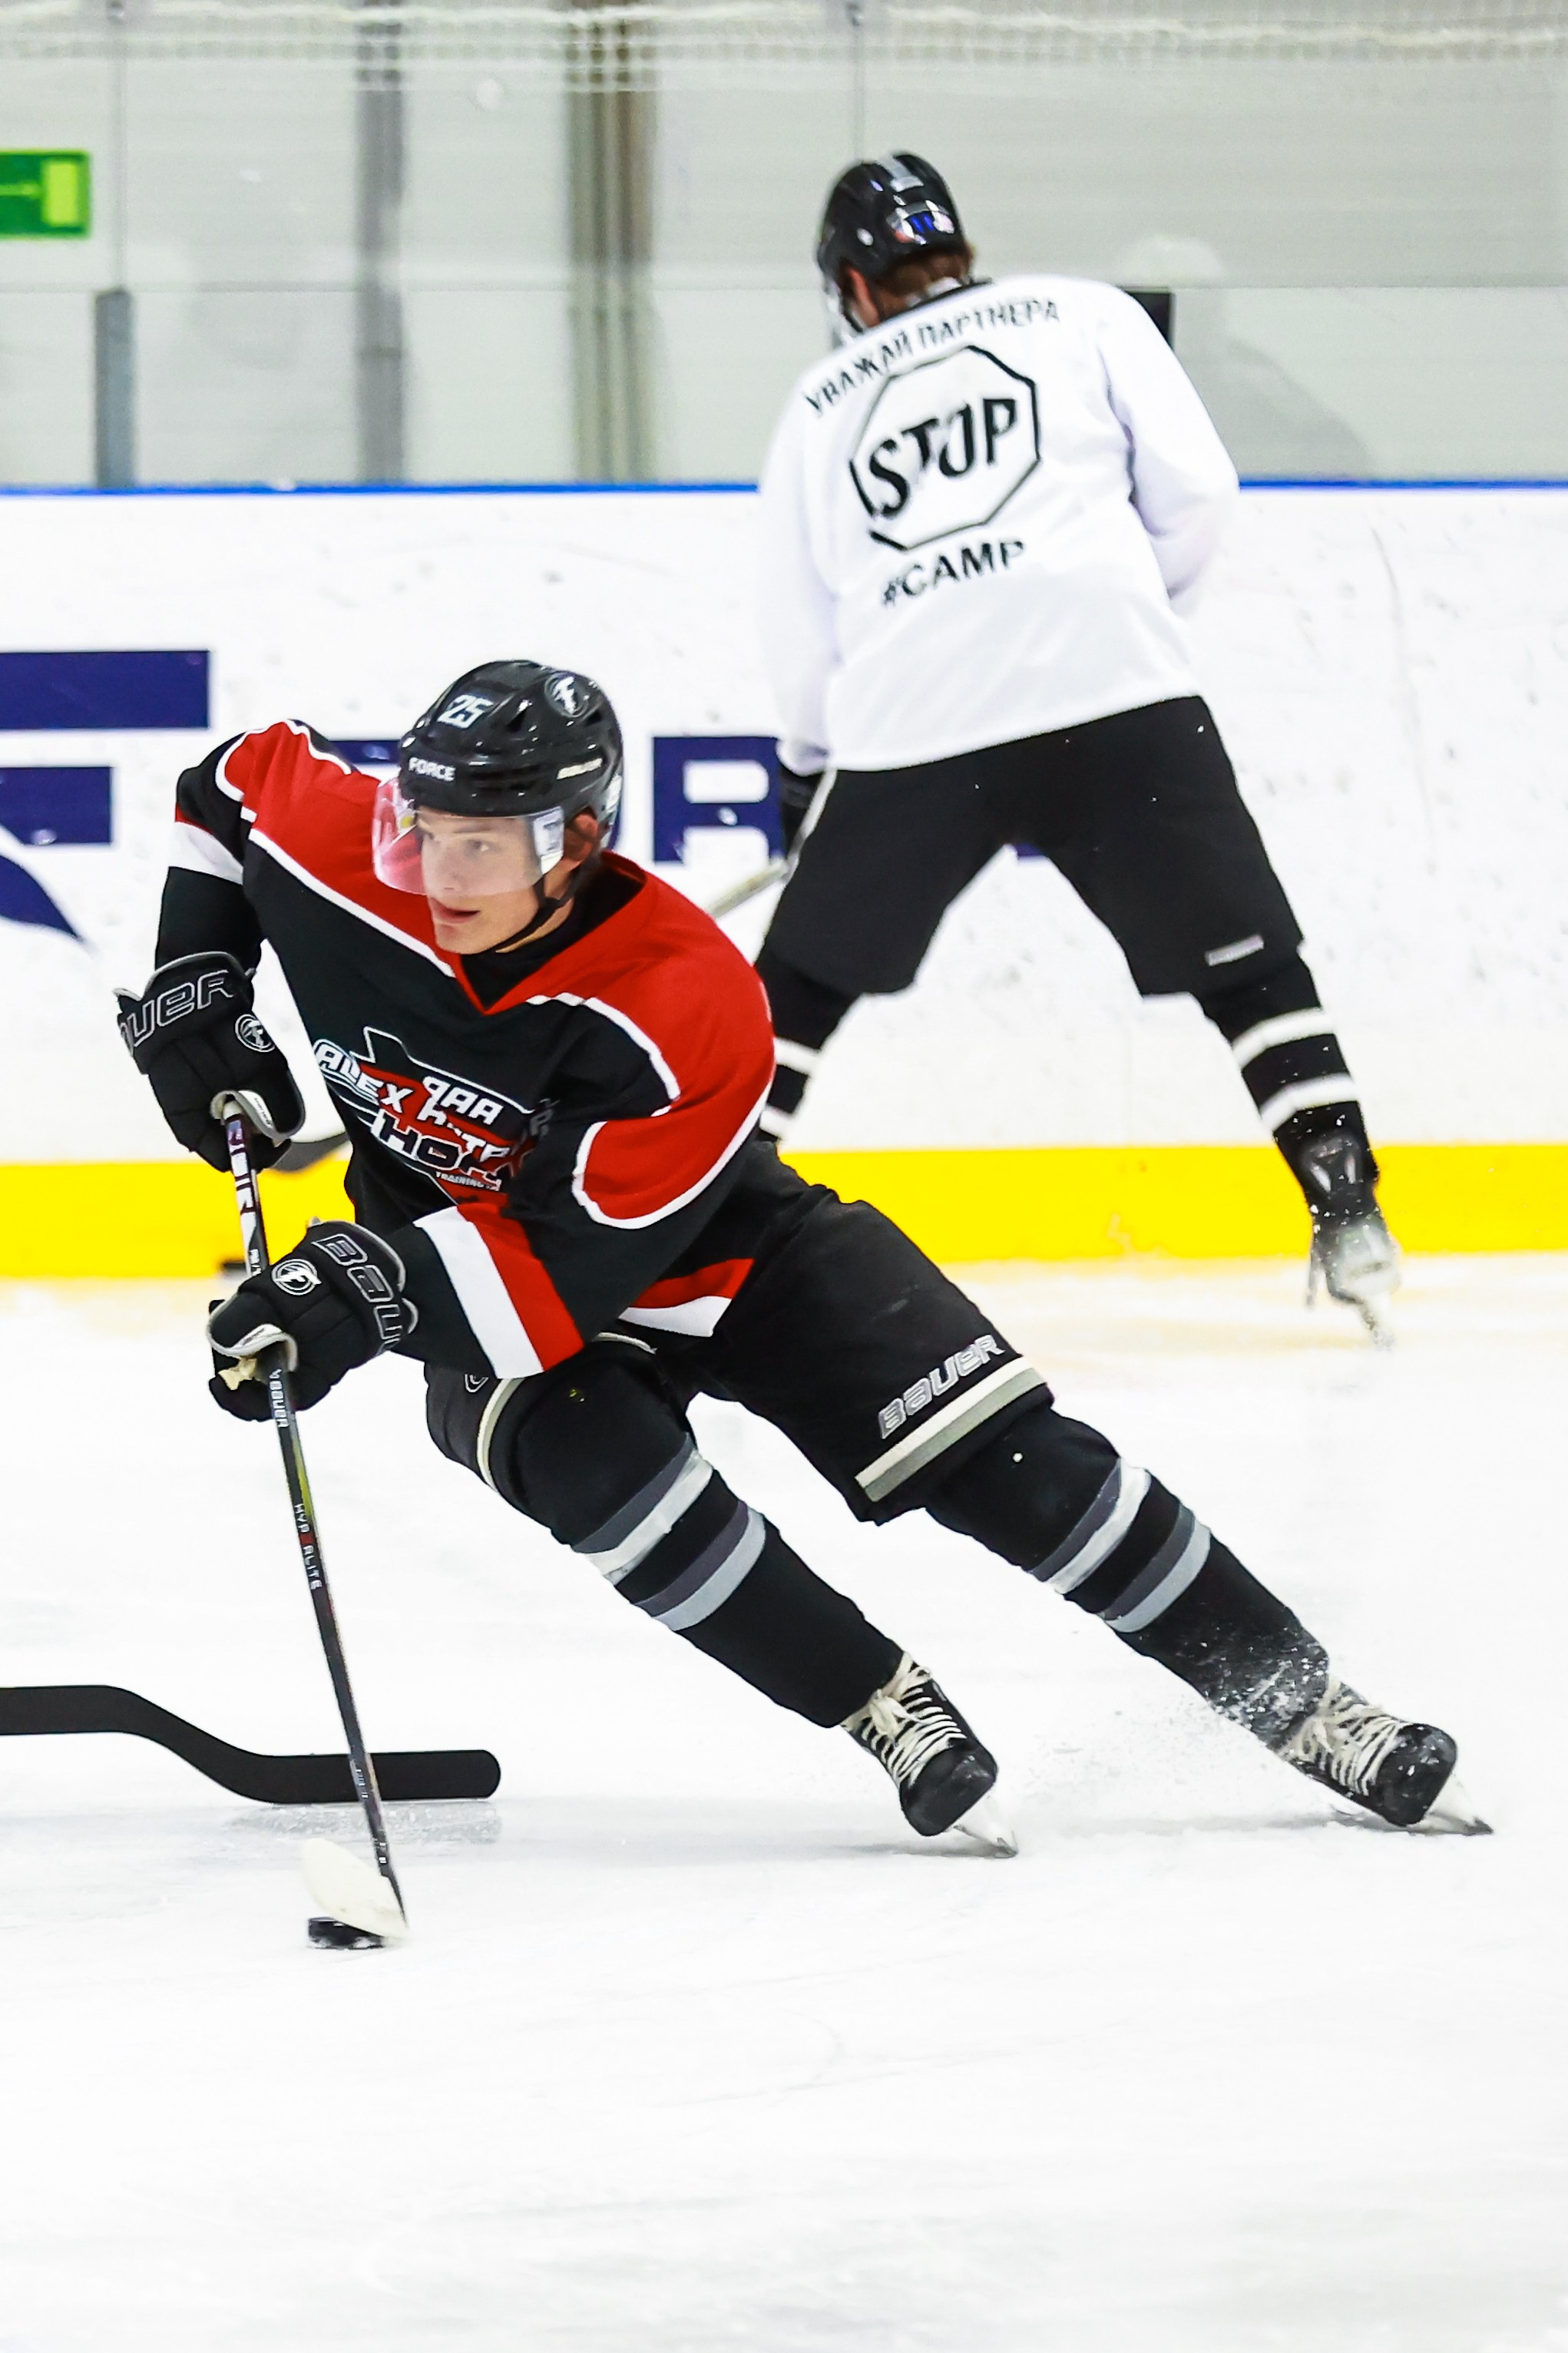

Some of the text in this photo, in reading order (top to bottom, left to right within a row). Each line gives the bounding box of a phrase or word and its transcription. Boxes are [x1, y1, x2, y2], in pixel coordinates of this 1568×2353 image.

[917, 297, 1061, 347] ПАРТНЕРА
[868, 398, 1017, 519] STOP
[882, 540, 1025, 607] #CAMP
[437, 693, 494, 729] 25
[409, 757, 457, 783] FORCE
[119, 969, 234, 1057] UER
[315, 1044, 415, 1114] ALEX
[311, 1233, 403, 1354] BAU
[878, 1334, 1005, 1440] BAUER
[293, 1503, 323, 1591] HYPRLITE
